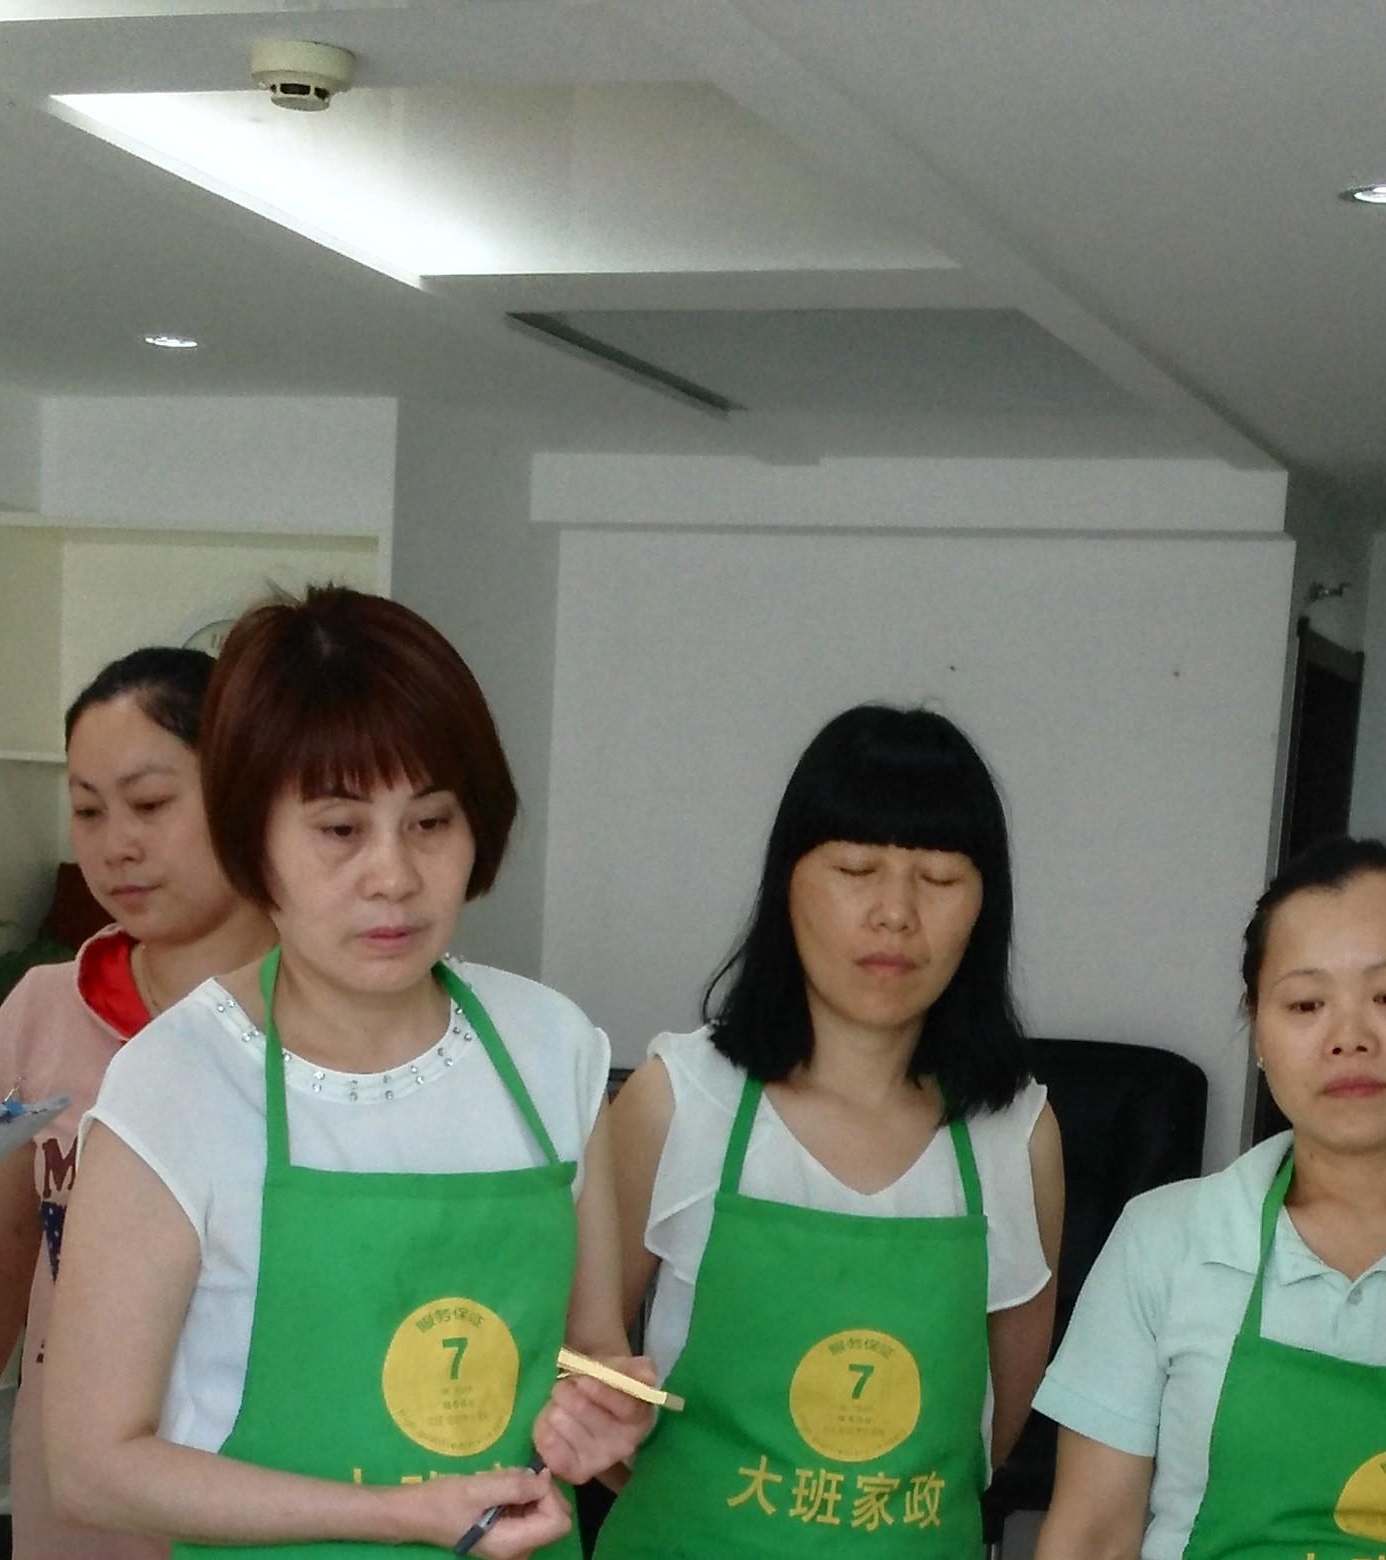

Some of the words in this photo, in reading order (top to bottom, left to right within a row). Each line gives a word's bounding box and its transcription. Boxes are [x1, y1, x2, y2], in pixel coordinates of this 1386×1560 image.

[442, 1337, 469, 1380] 7
[848, 1363, 876, 1400] 7
[726, 1454, 945, 1532] 大班家政
